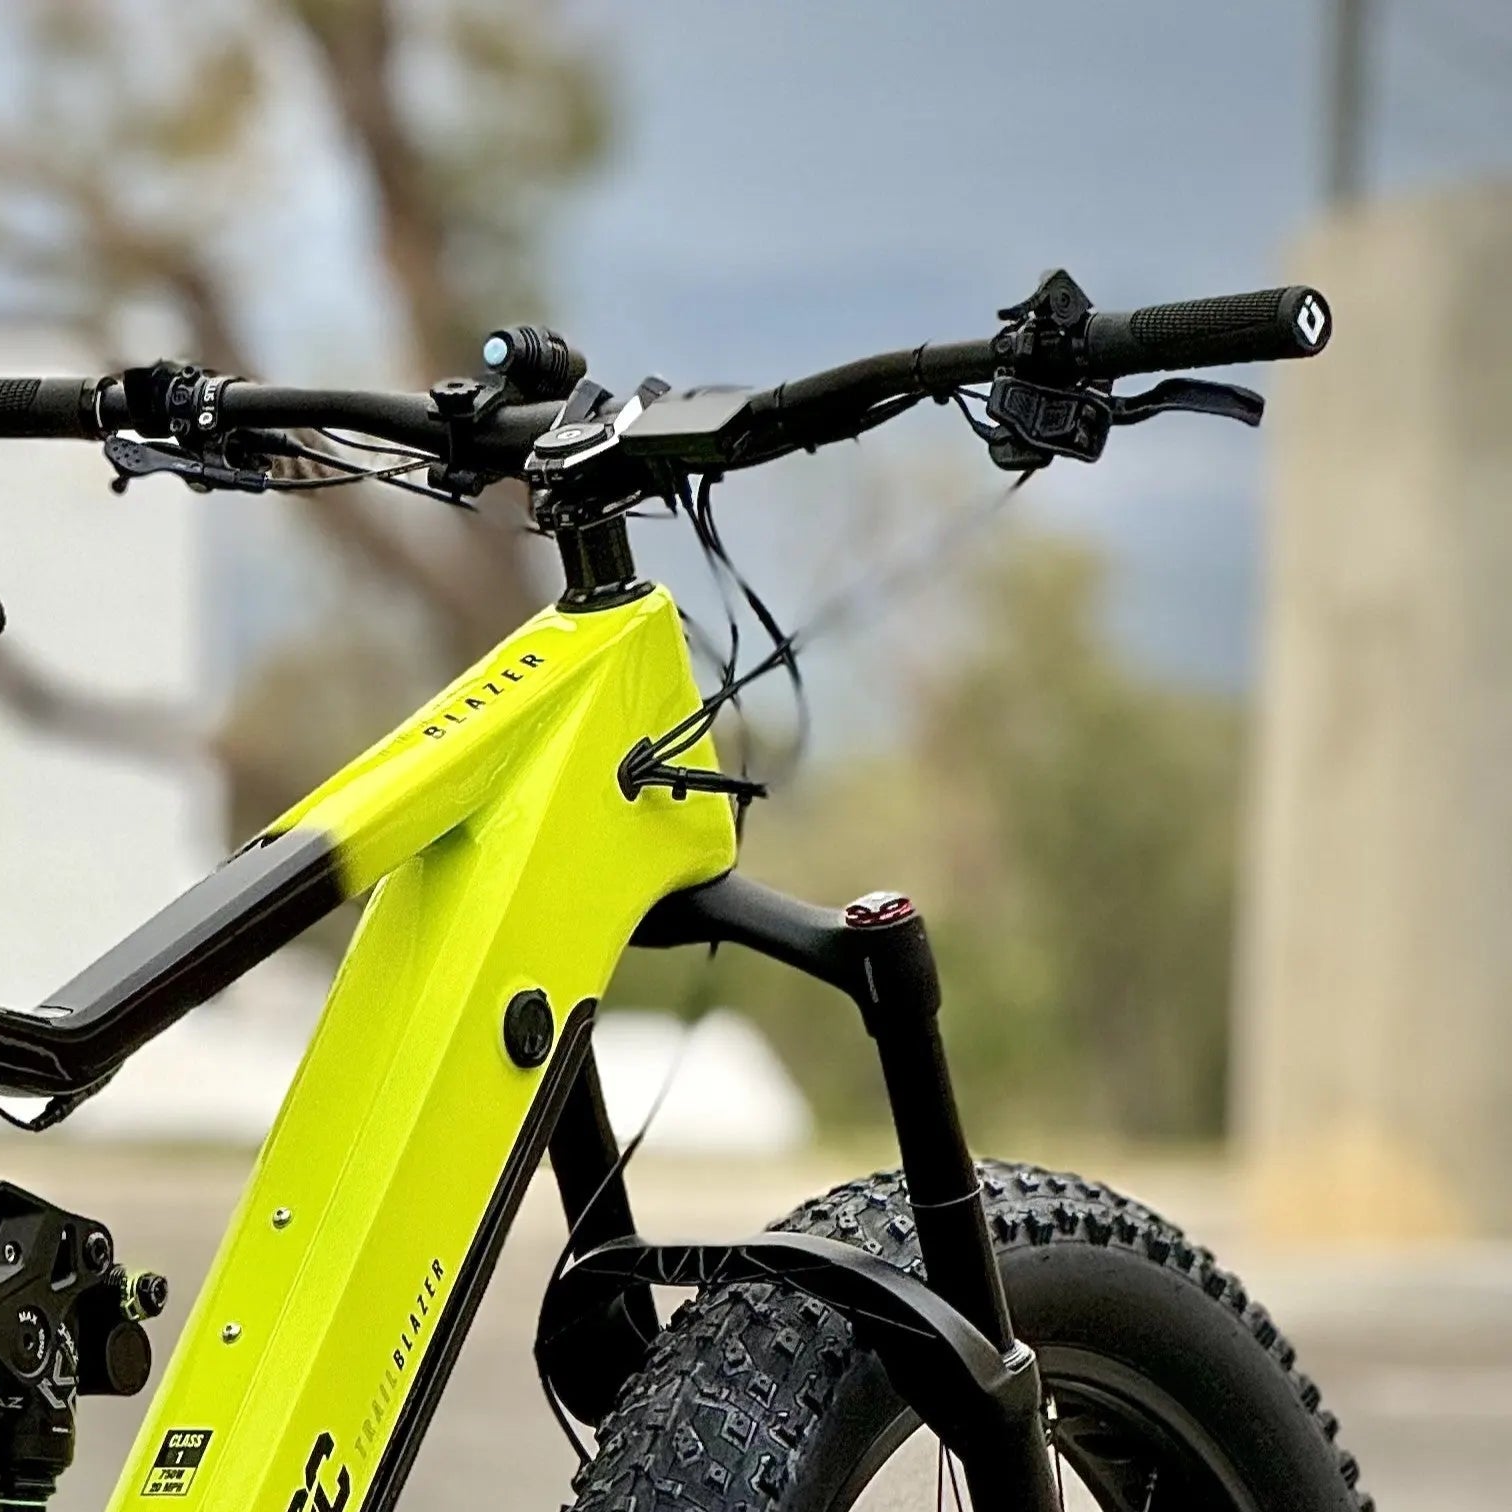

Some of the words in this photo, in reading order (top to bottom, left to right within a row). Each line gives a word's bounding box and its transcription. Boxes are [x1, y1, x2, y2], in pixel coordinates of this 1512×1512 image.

[423, 654, 545, 739] BLAZER
[169, 1433, 204, 1449] CLASS
[175, 1450, 184, 1464] 1
